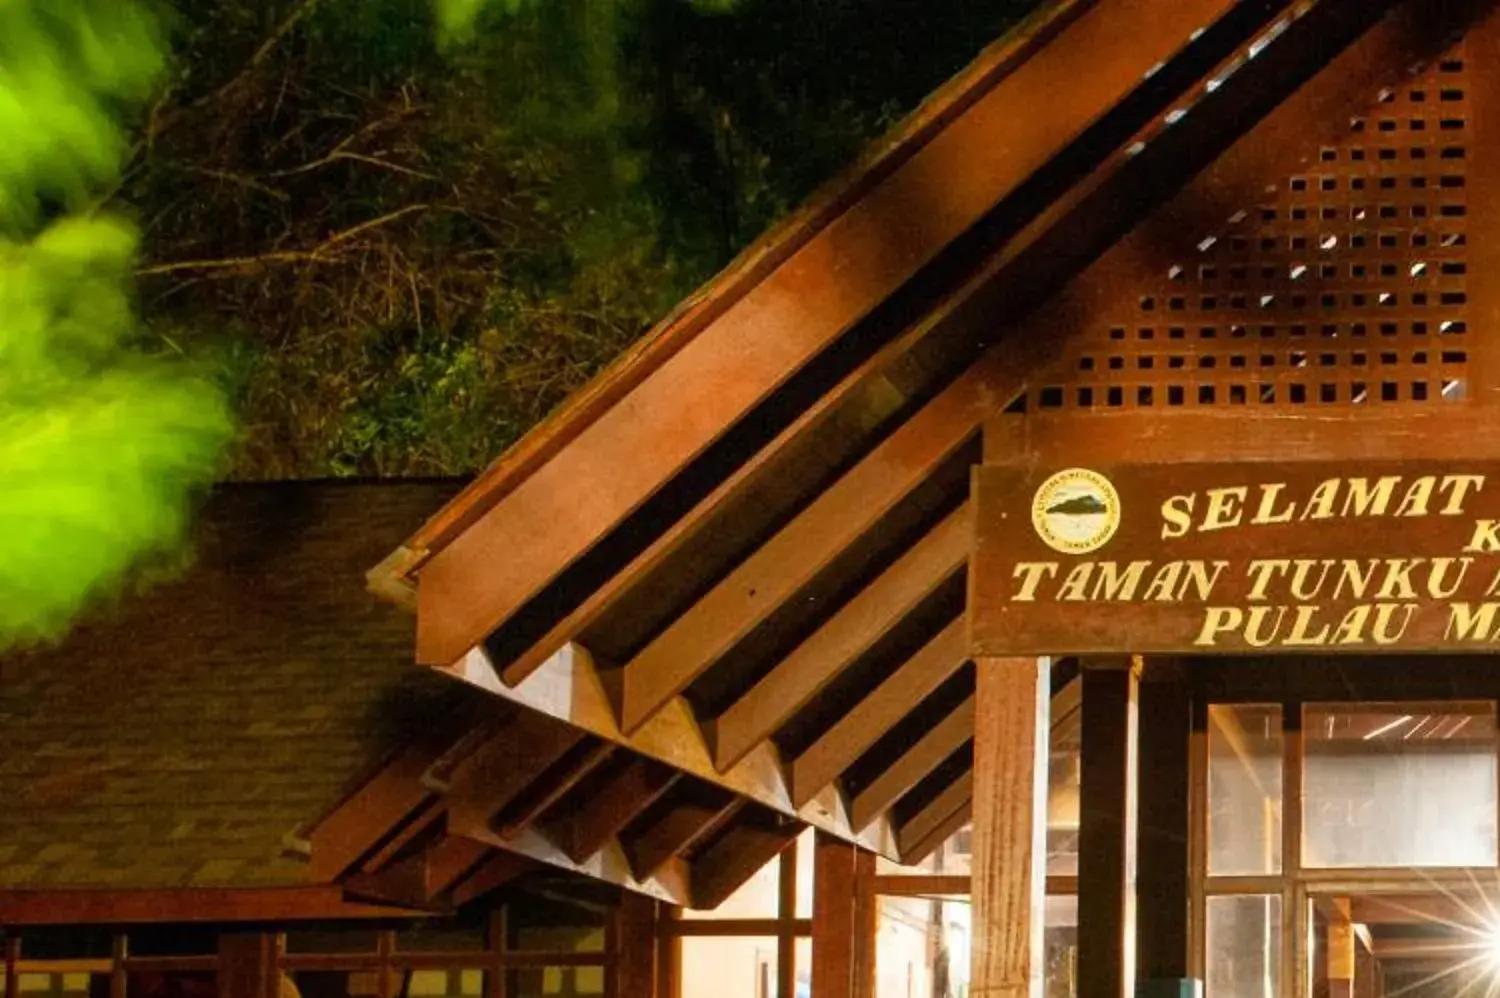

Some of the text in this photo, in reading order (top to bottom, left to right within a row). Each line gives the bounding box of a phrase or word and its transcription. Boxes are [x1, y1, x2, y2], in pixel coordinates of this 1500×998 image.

[1160, 474, 1486, 540] SELAMAT
[1011, 560, 1229, 602] TAMAN
[1247, 557, 1475, 602] TUNKU
[1194, 601, 1418, 647] PULAU
